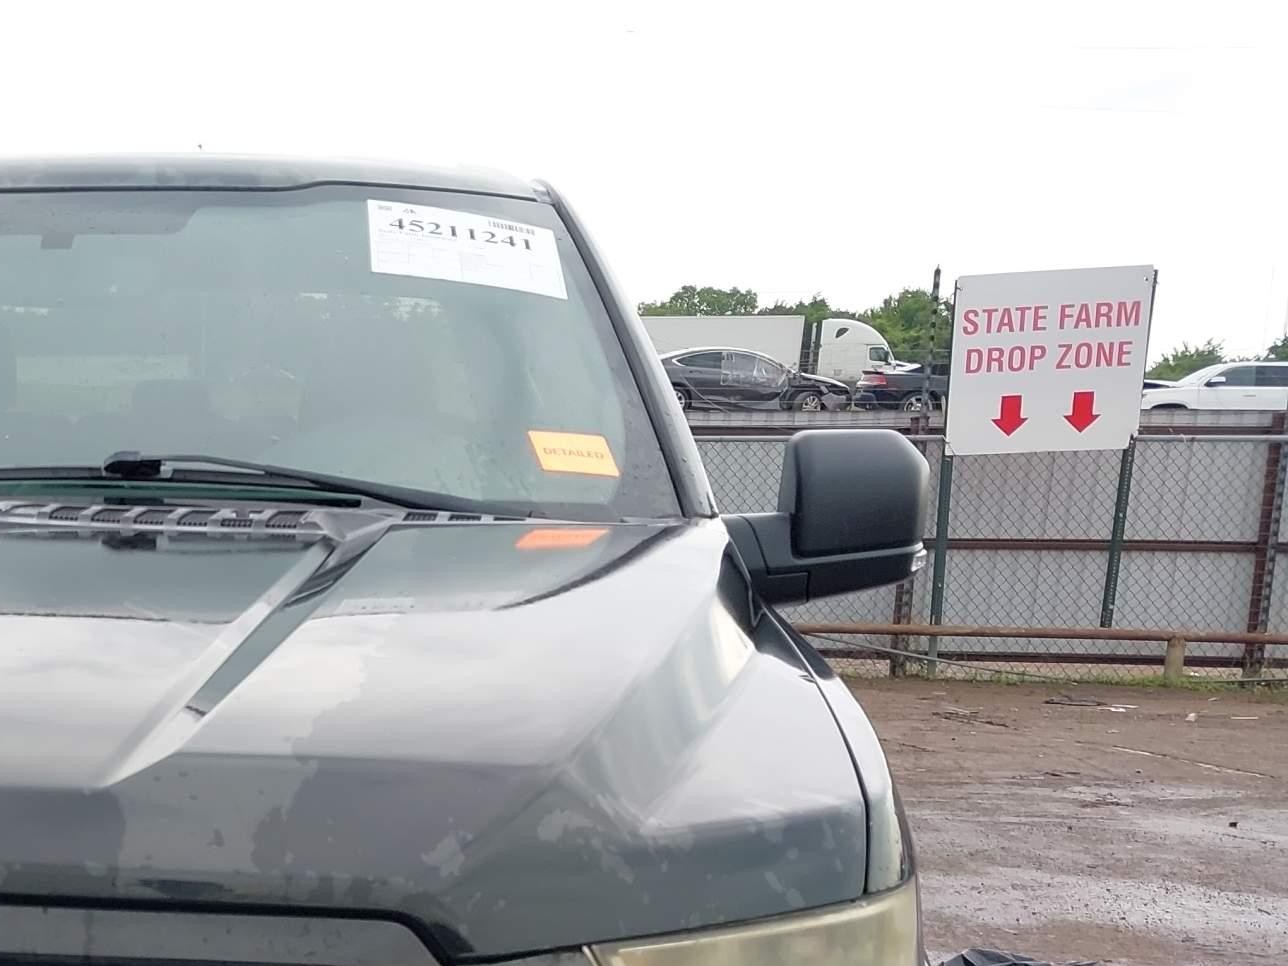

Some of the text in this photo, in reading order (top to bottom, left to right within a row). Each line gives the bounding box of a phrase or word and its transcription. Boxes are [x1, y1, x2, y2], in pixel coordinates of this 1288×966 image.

[389, 218, 534, 251] 45211241
[962, 301, 1142, 336] STATE FARM
[965, 341, 1134, 374] DROP ZONE
